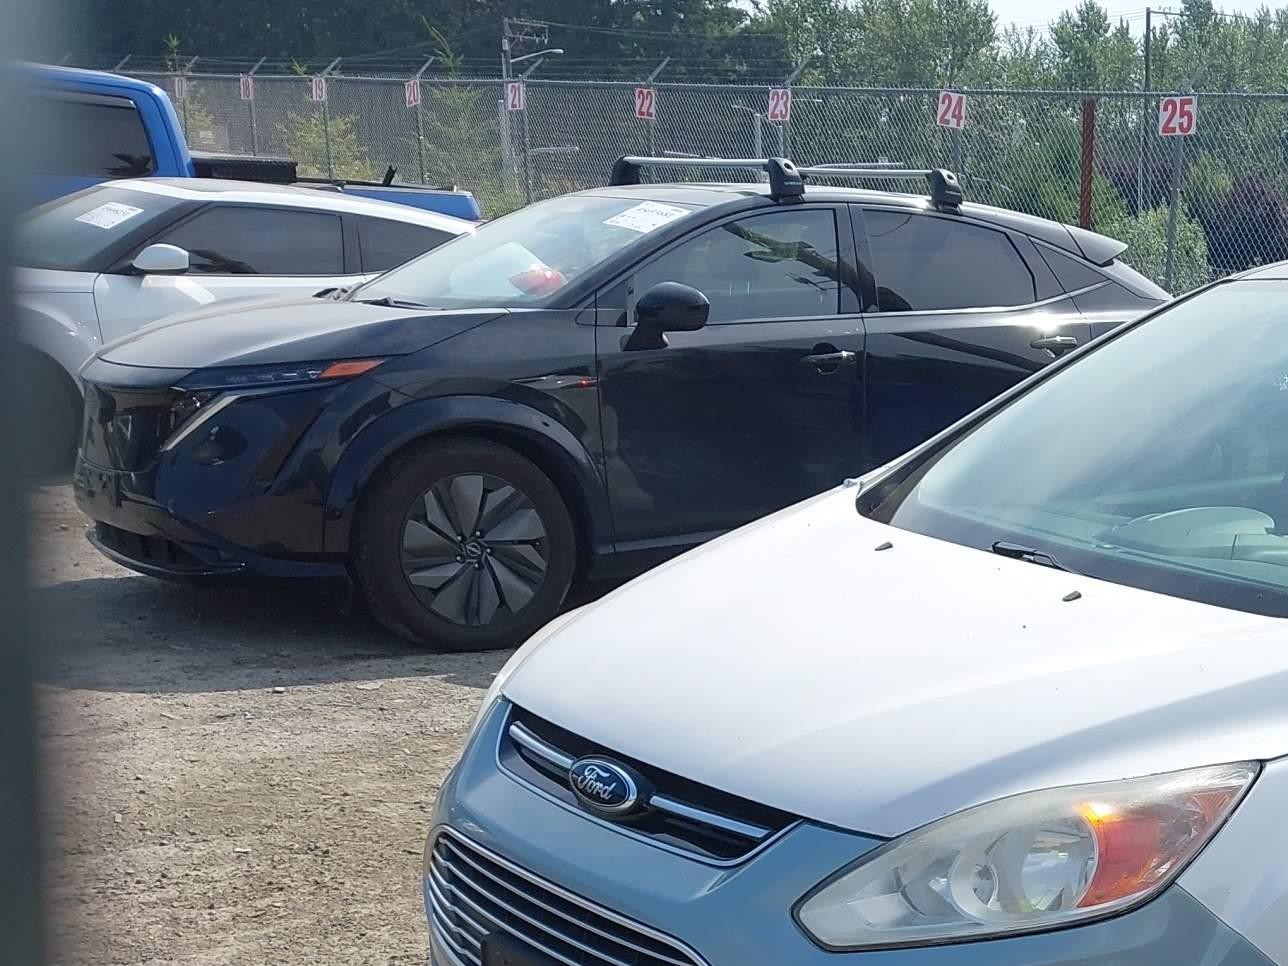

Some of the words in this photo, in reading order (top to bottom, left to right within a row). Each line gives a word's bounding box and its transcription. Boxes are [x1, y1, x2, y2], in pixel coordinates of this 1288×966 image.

[242, 79, 251, 98] 18
[314, 79, 325, 100] 19
[407, 81, 419, 106] 20
[511, 84, 522, 109] 21
[637, 90, 654, 118] 22
[770, 90, 789, 120] 23
[939, 93, 964, 128] 24
[1161, 98, 1194, 134] 25
[577, 765, 617, 800] Ford
